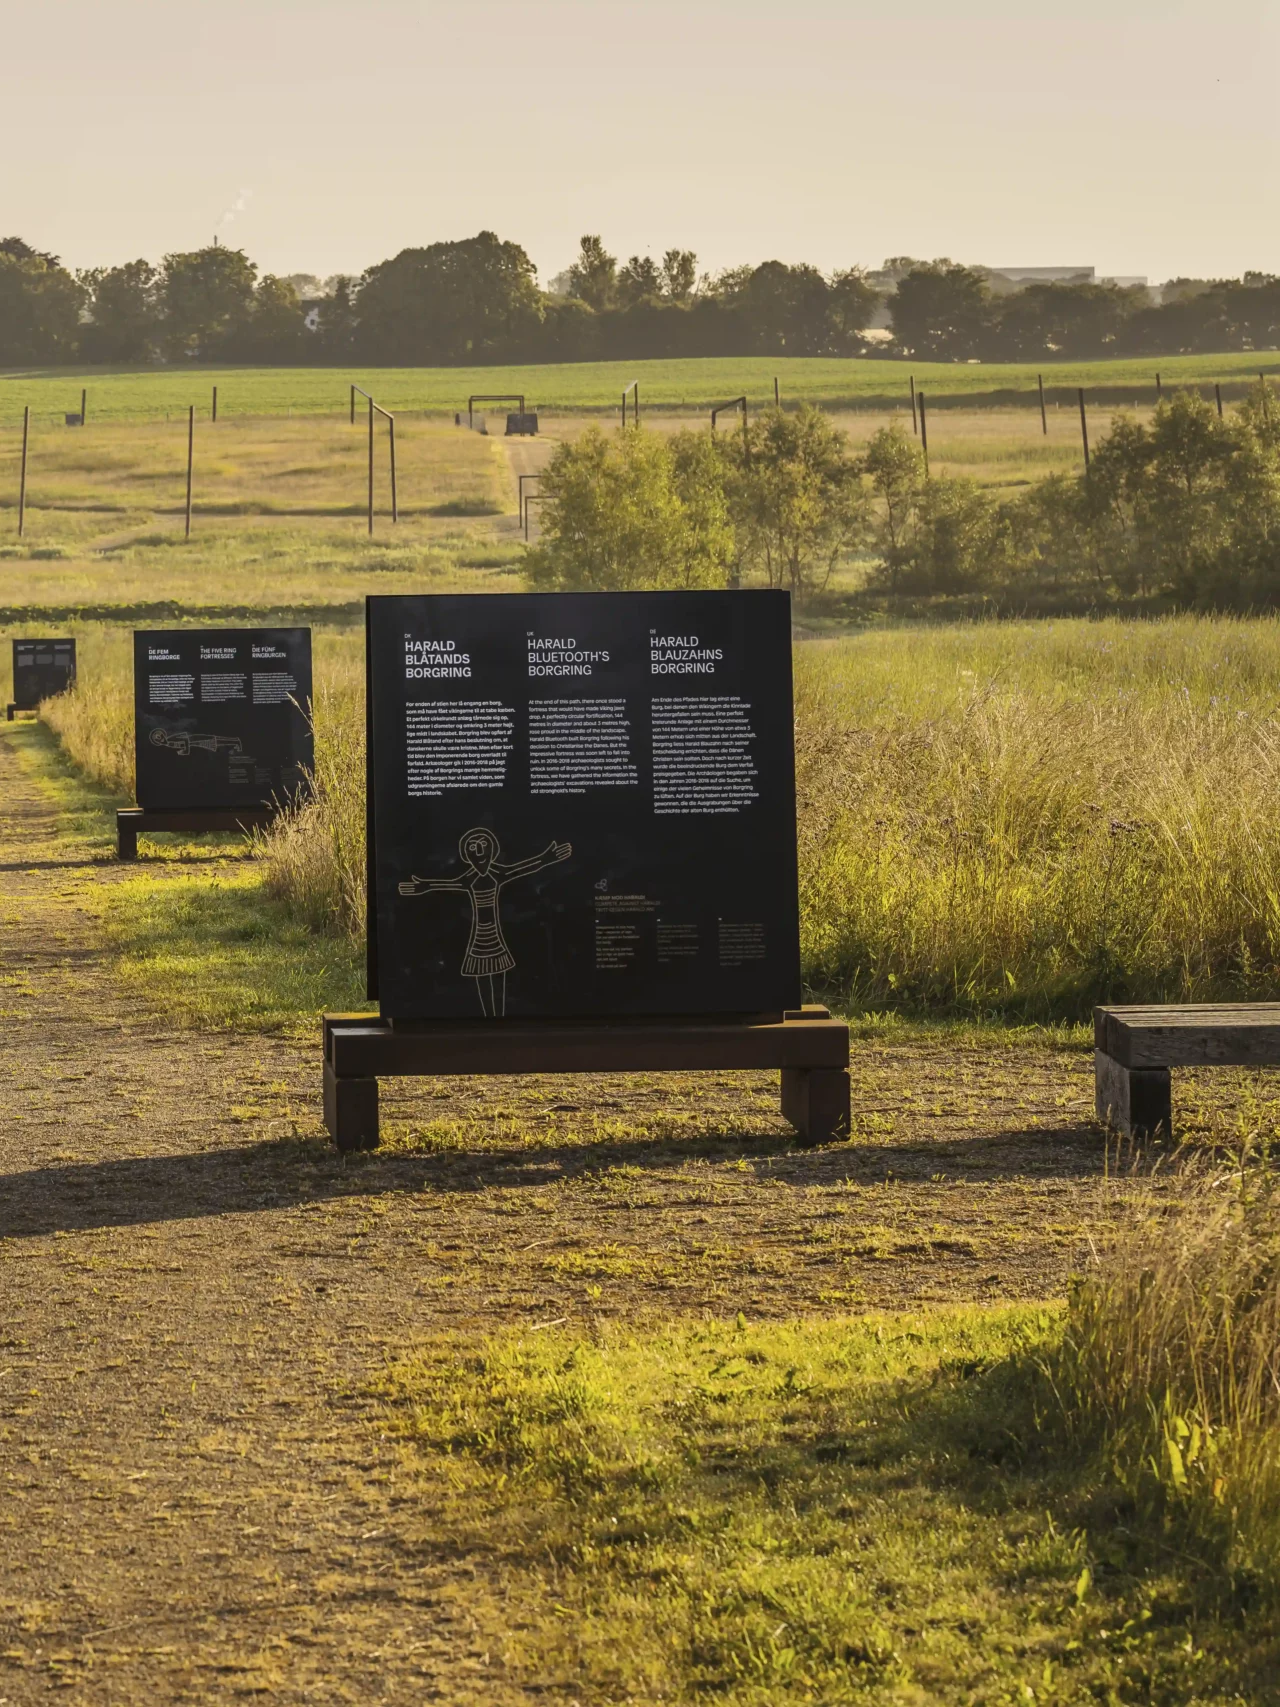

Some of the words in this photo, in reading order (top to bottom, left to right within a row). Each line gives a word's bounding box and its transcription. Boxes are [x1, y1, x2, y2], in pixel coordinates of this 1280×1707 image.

[405, 640, 455, 651] HARALD
[528, 639, 575, 650] HARALD
[650, 636, 698, 647] HARALD
[406, 651, 470, 665] BLÅTANDS
[528, 651, 609, 663] BLUETOOTH'S
[651, 649, 722, 661] BLAUZAHNS
[406, 666, 471, 678] BORGRING
[529, 665, 591, 676] BORGRING
[651, 662, 714, 674] BORGRING
